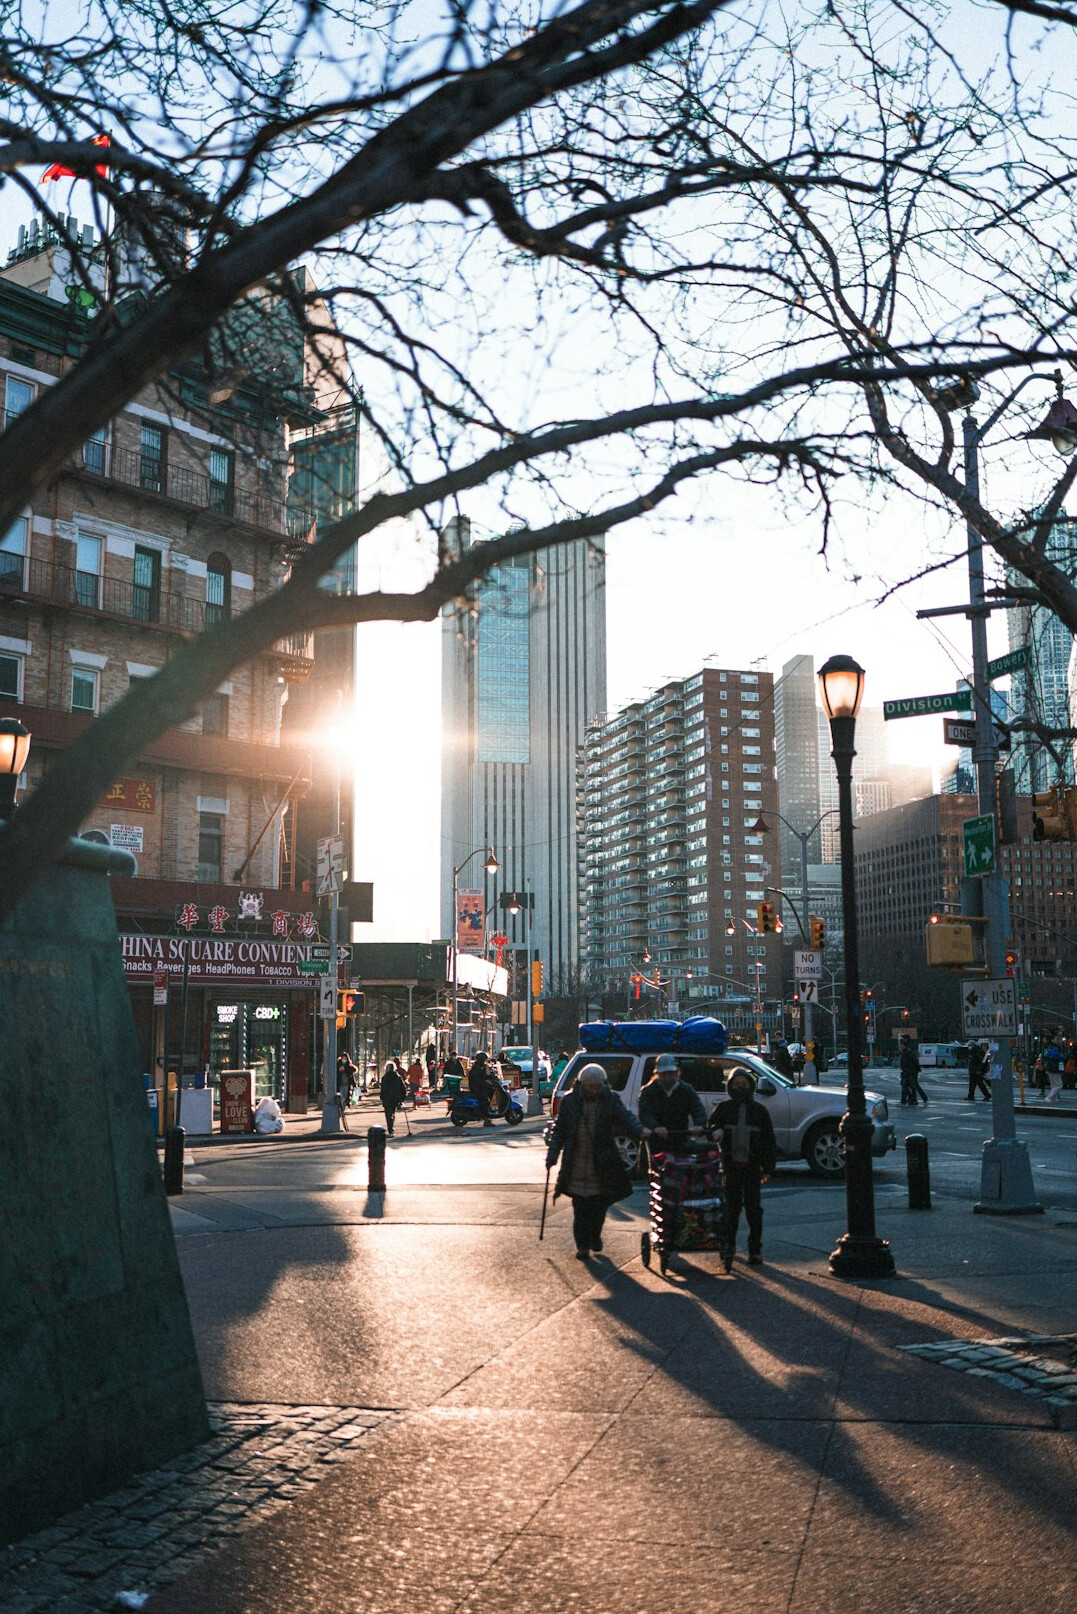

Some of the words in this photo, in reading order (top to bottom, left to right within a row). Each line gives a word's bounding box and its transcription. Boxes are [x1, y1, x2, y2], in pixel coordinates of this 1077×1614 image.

[990, 650, 1027, 674] Bowery
[886, 695, 953, 714] Division
[953, 727, 972, 739] ONE
[119, 936, 164, 958] HINA
[169, 938, 234, 962] SQUARE
[801, 954, 815, 963] NO
[122, 959, 152, 972] Snacks
[157, 961, 201, 975] Beverages
[205, 962, 256, 974] HeadPhones
[795, 966, 821, 975] TURNS
[992, 990, 1013, 1005] USE
[217, 1005, 238, 1014] SMOKE
[218, 1014, 236, 1022] SHOP
[965, 1012, 1014, 1028] CROSSWALK
[225, 1107, 248, 1118] LOVE
